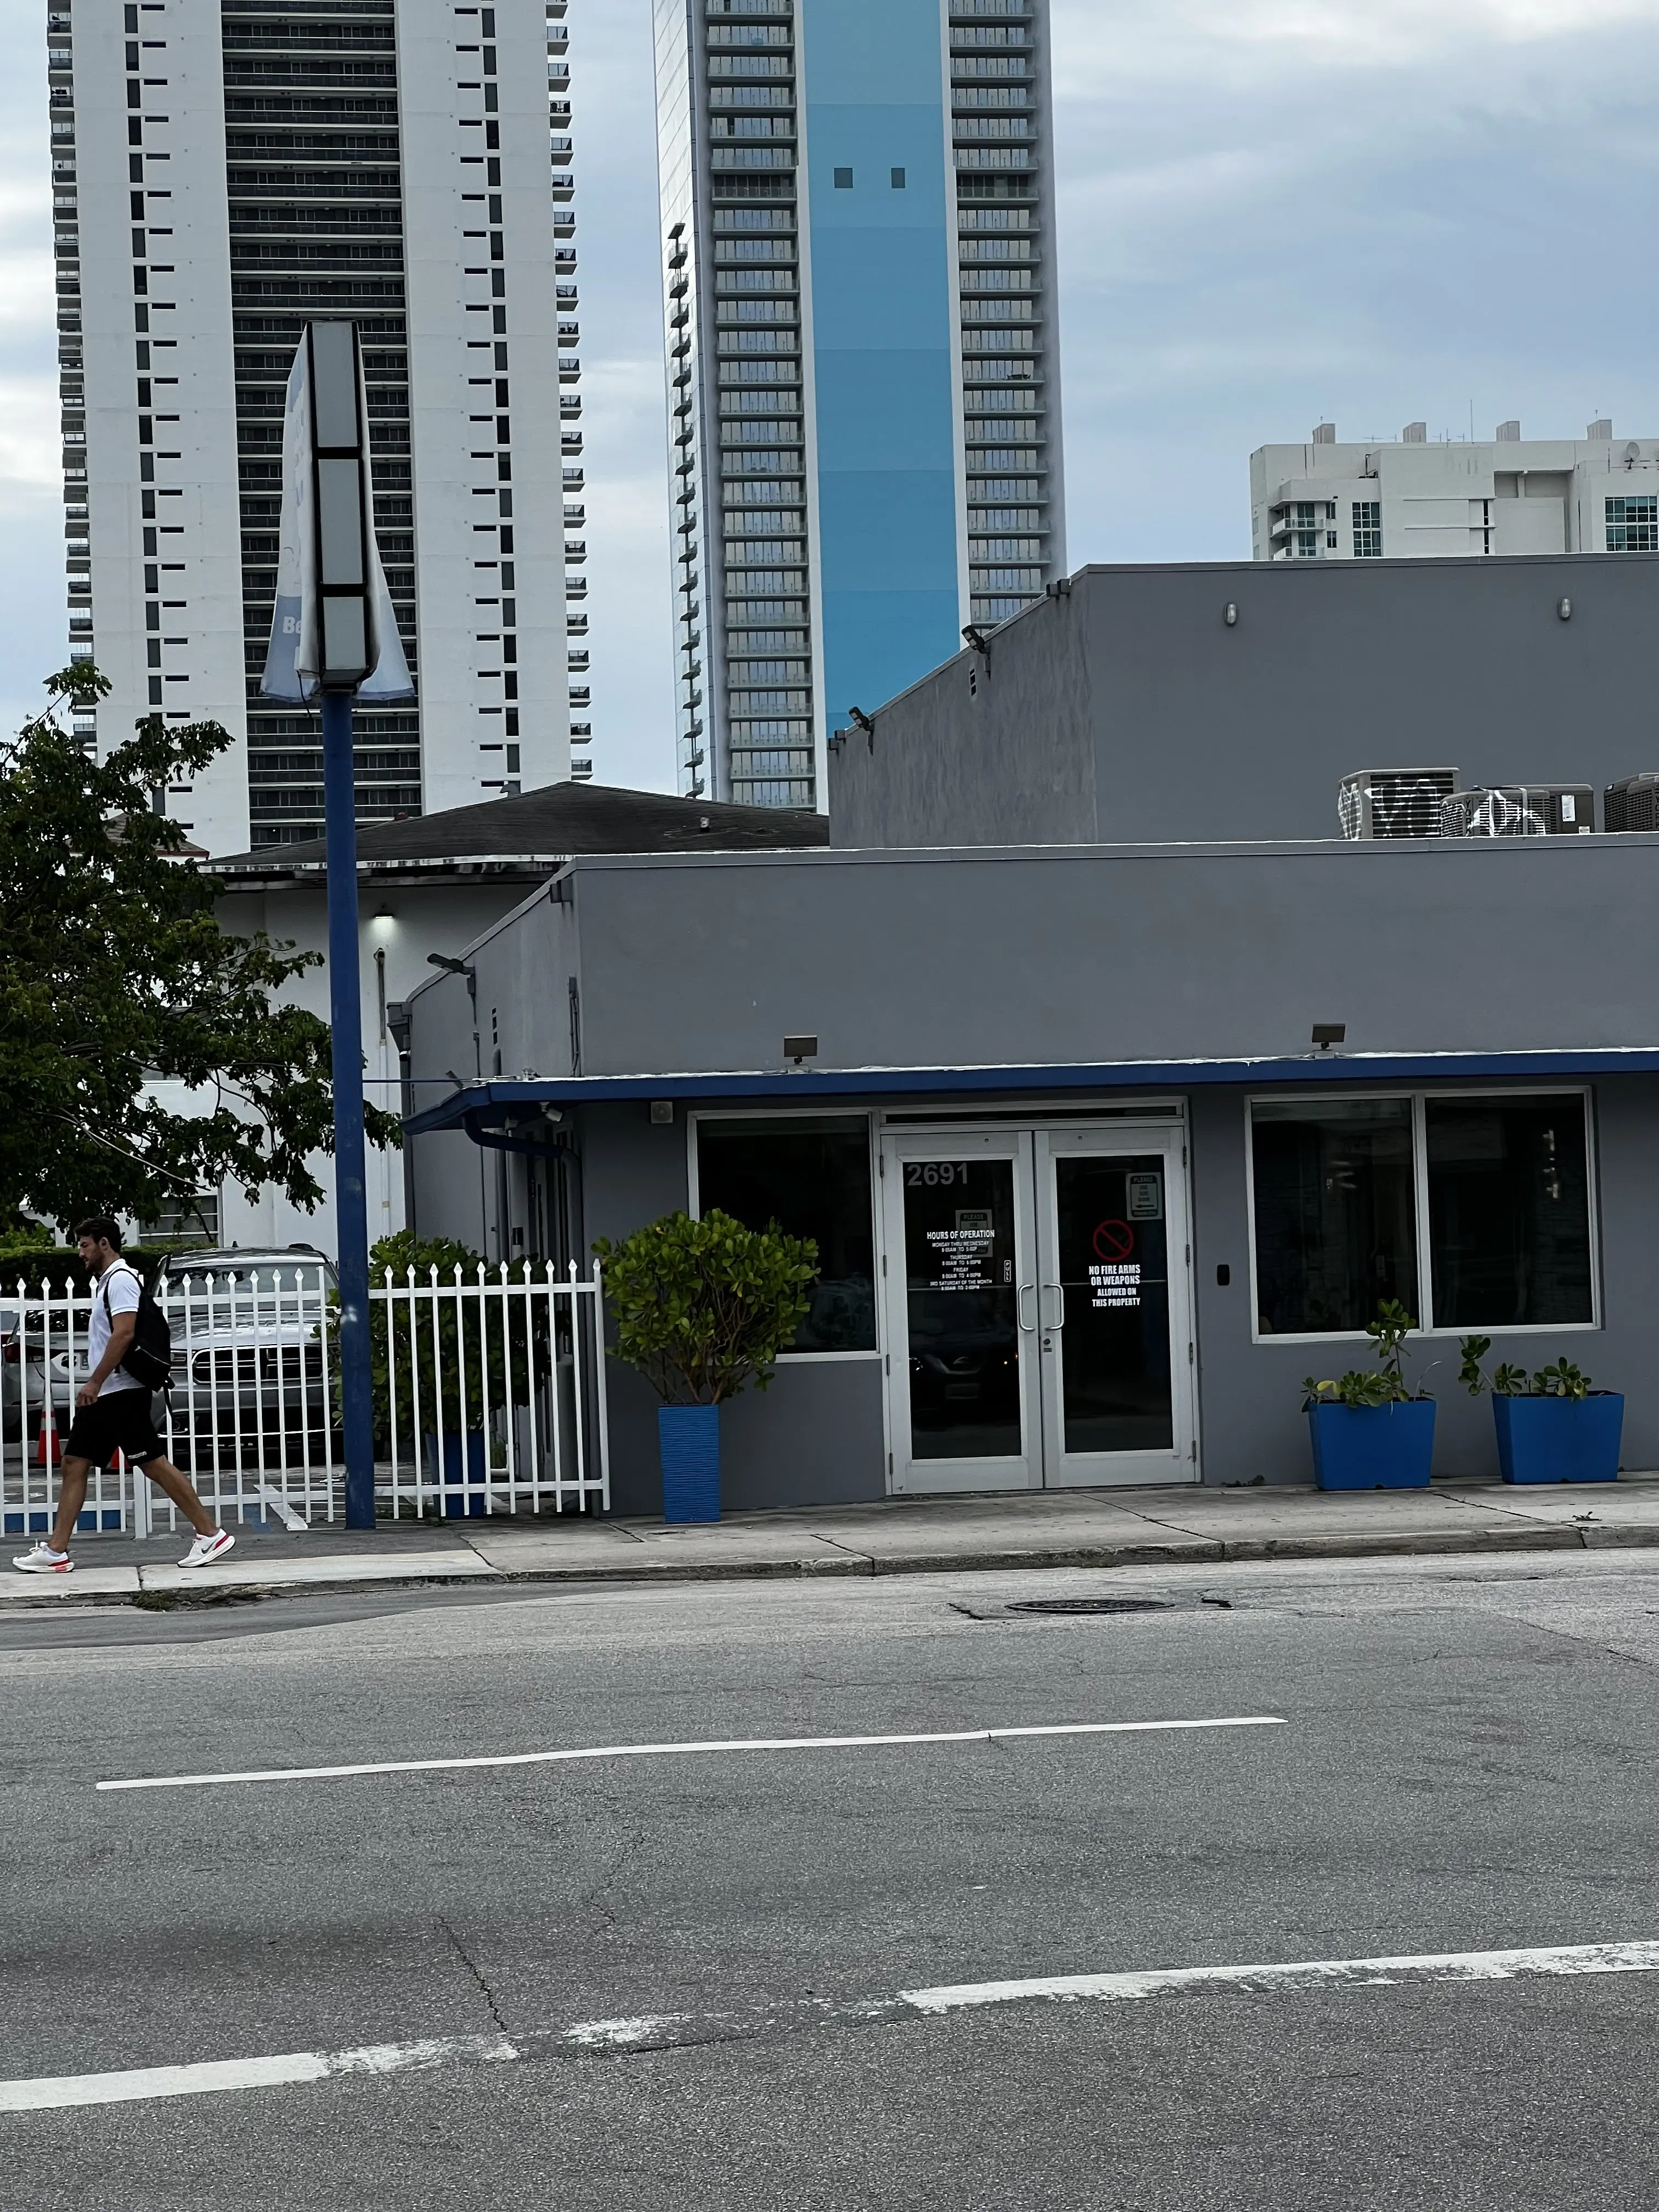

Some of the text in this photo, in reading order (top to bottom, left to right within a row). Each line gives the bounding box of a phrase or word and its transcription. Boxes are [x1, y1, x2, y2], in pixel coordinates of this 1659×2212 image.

[907, 1163, 968, 1186] 2691
[927, 1229, 995, 1239] HOURS OF OPERATION
[1089, 1264, 1141, 1275] NO FIRE ARMS
[1091, 1275, 1140, 1286] OR WEAPONS
[1097, 1287, 1136, 1296] ALLOWED ON
[1092, 1297, 1141, 1307] THIS PROPERTY
